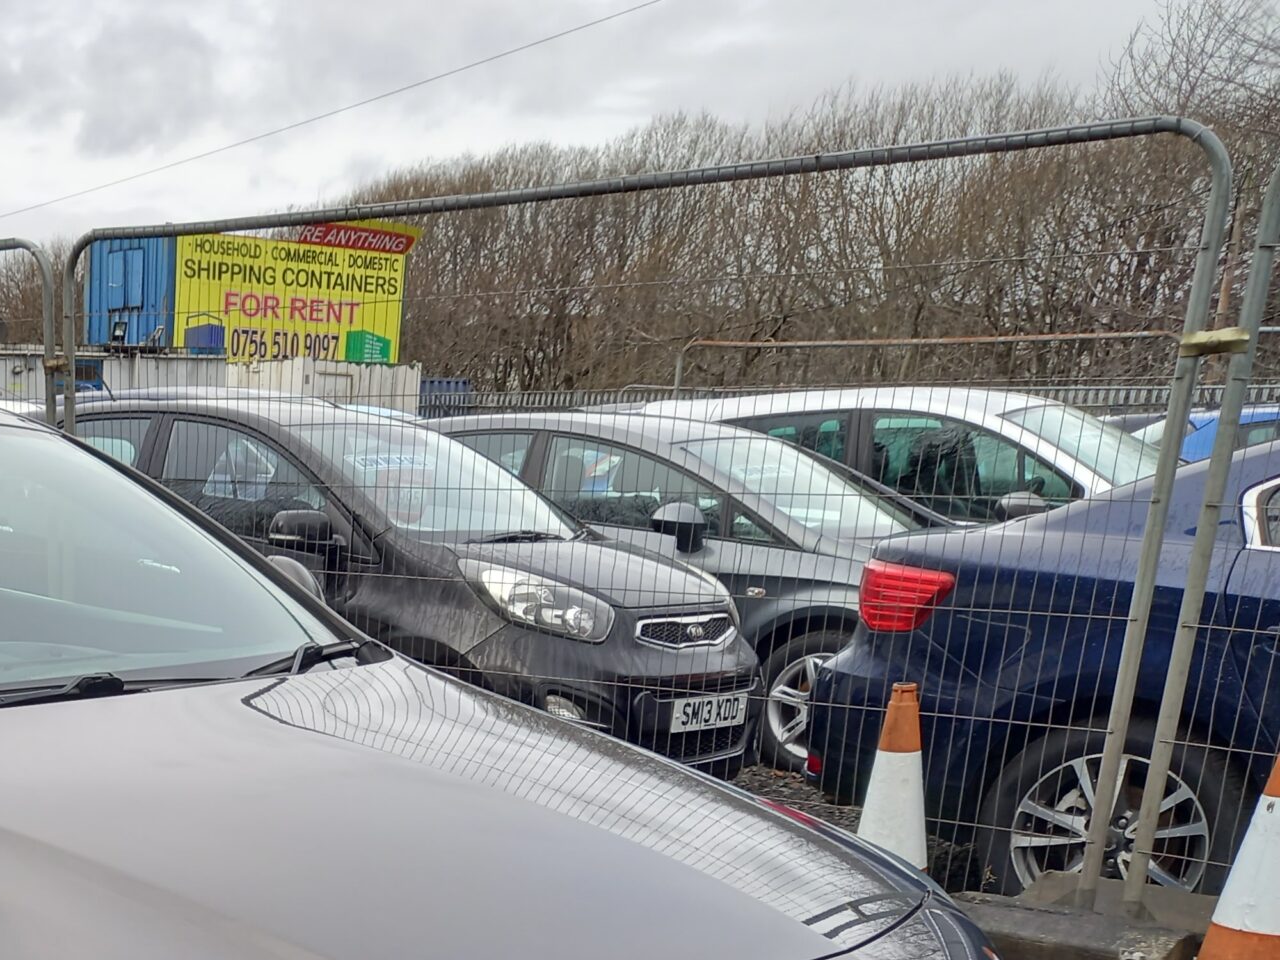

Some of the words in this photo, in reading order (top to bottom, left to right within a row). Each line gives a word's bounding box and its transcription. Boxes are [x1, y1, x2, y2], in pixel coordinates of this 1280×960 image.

[194, 238, 262, 259] HOUSEHOLD
[271, 246, 339, 267] COMMERCIAL
[348, 254, 399, 272] DOMESTIC
[324, 228, 407, 251] ANYTHING
[184, 259, 276, 286] SHIPPING
[282, 267, 398, 295] CONTAINERS
[224, 292, 280, 320] FOR
[289, 297, 361, 325] RENT
[231, 329, 268, 358] 0756
[272, 331, 299, 359] 510
[304, 333, 340, 360] 9097
[681, 700, 713, 726] SM13
[714, 697, 740, 722] XDD
